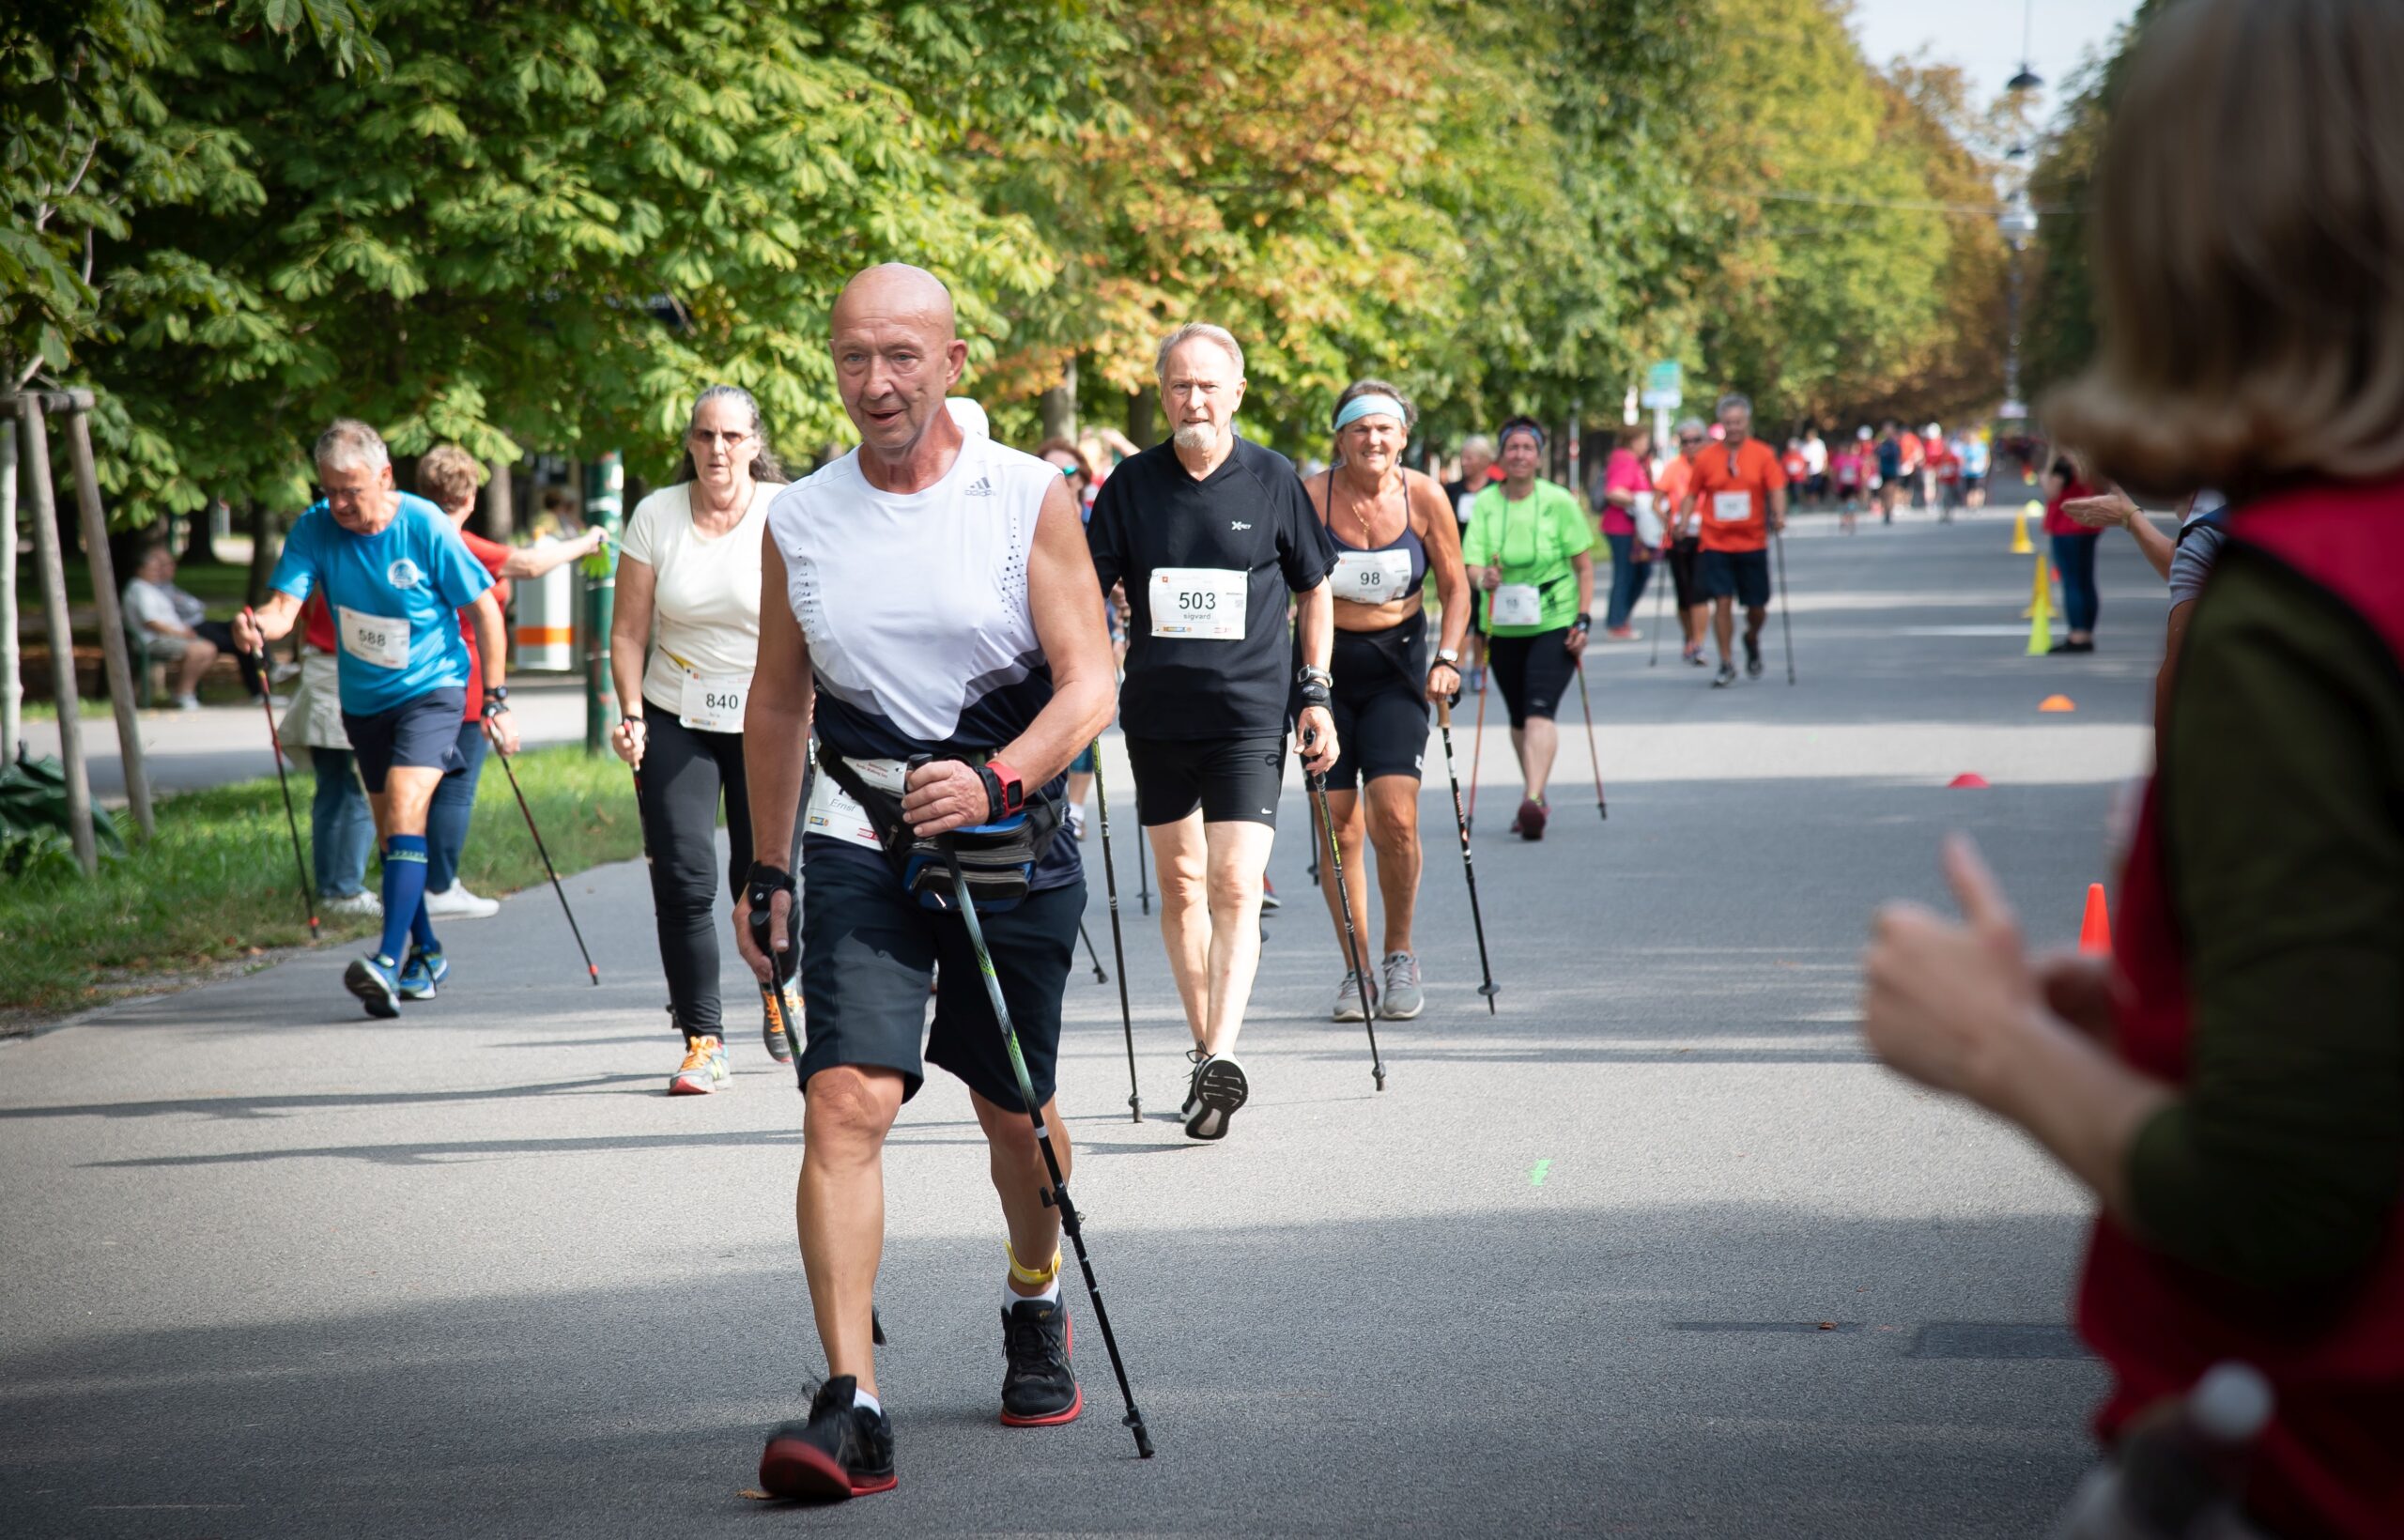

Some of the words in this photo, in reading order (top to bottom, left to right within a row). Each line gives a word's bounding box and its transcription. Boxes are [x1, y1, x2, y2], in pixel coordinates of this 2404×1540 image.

[1360, 572, 1380, 585] 98
[1179, 592, 1216, 609] 503
[1183, 612, 1211, 621] sigvard
[359, 629, 387, 647] 588
[706, 693, 738, 709] 840
